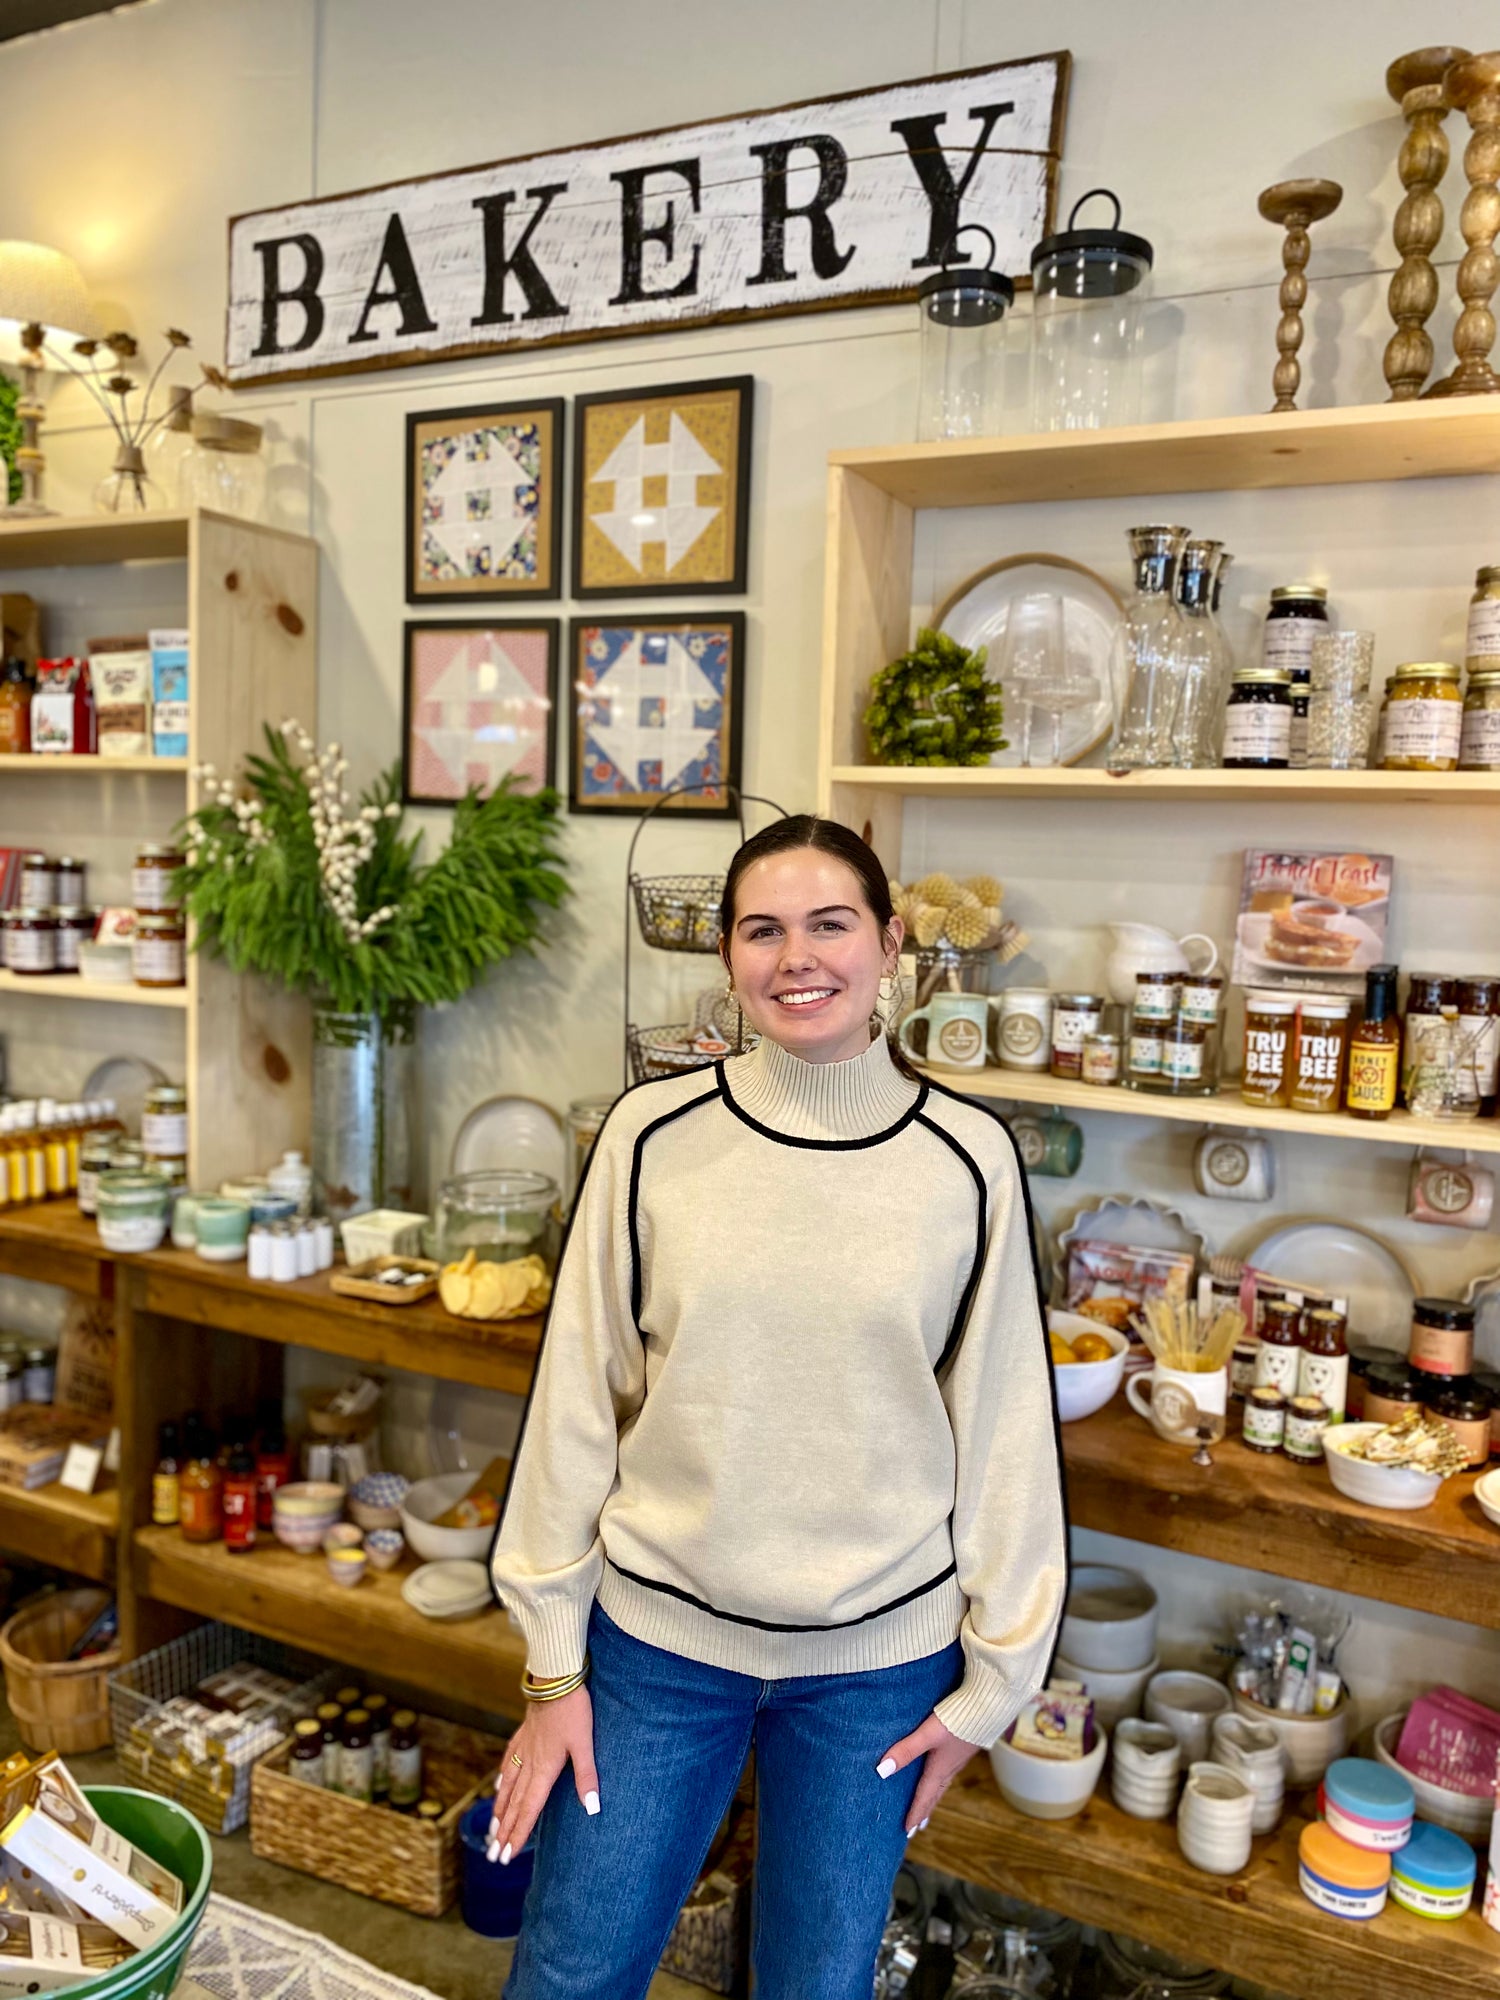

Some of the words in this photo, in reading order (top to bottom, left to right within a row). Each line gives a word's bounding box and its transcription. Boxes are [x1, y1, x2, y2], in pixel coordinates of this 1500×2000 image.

[250, 101, 1015, 358] BAKERY
[1246, 1030, 1287, 1053] TRU
[1300, 1035, 1341, 1058] TRU
[1246, 1051, 1284, 1075] BEE
[1299, 1056, 1338, 1080] BEE
[1354, 1054, 1388, 1065] HONEY
[1352, 1066, 1387, 1085] HOT
[1352, 1085, 1386, 1101] SAUCE
